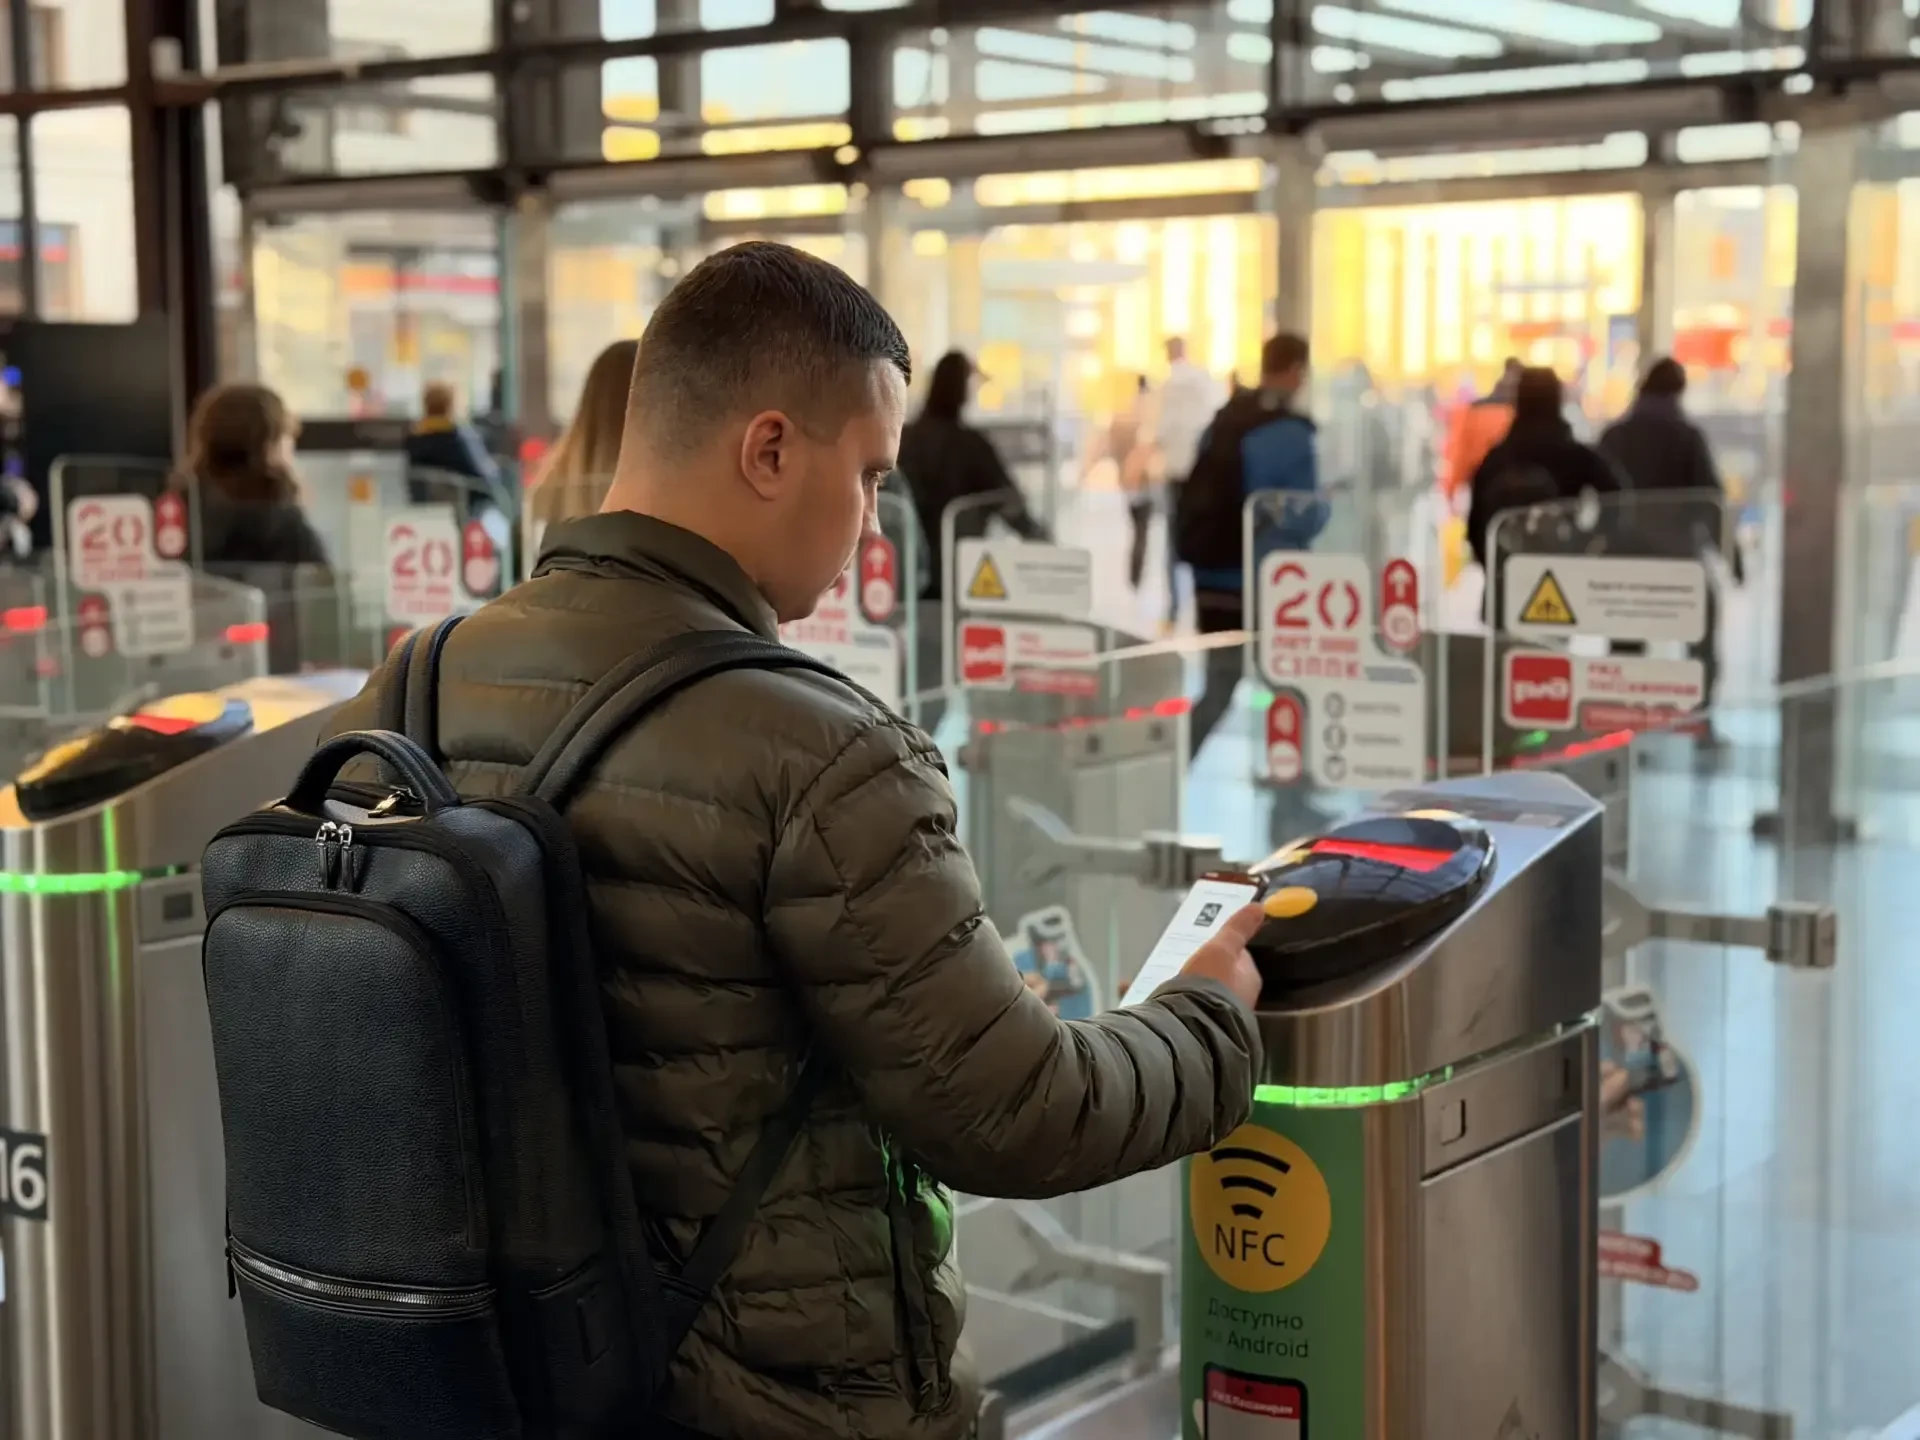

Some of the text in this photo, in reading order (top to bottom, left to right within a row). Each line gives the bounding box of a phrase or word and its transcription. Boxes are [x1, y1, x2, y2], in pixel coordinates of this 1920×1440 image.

[78, 503, 144, 549] 20
[391, 524, 453, 577] 20
[1271, 561, 1361, 630] 20
[1214, 1223, 1286, 1266] NFC
[1208, 1297, 1304, 1331] Доступно
[1227, 1331, 1309, 1359] Android
